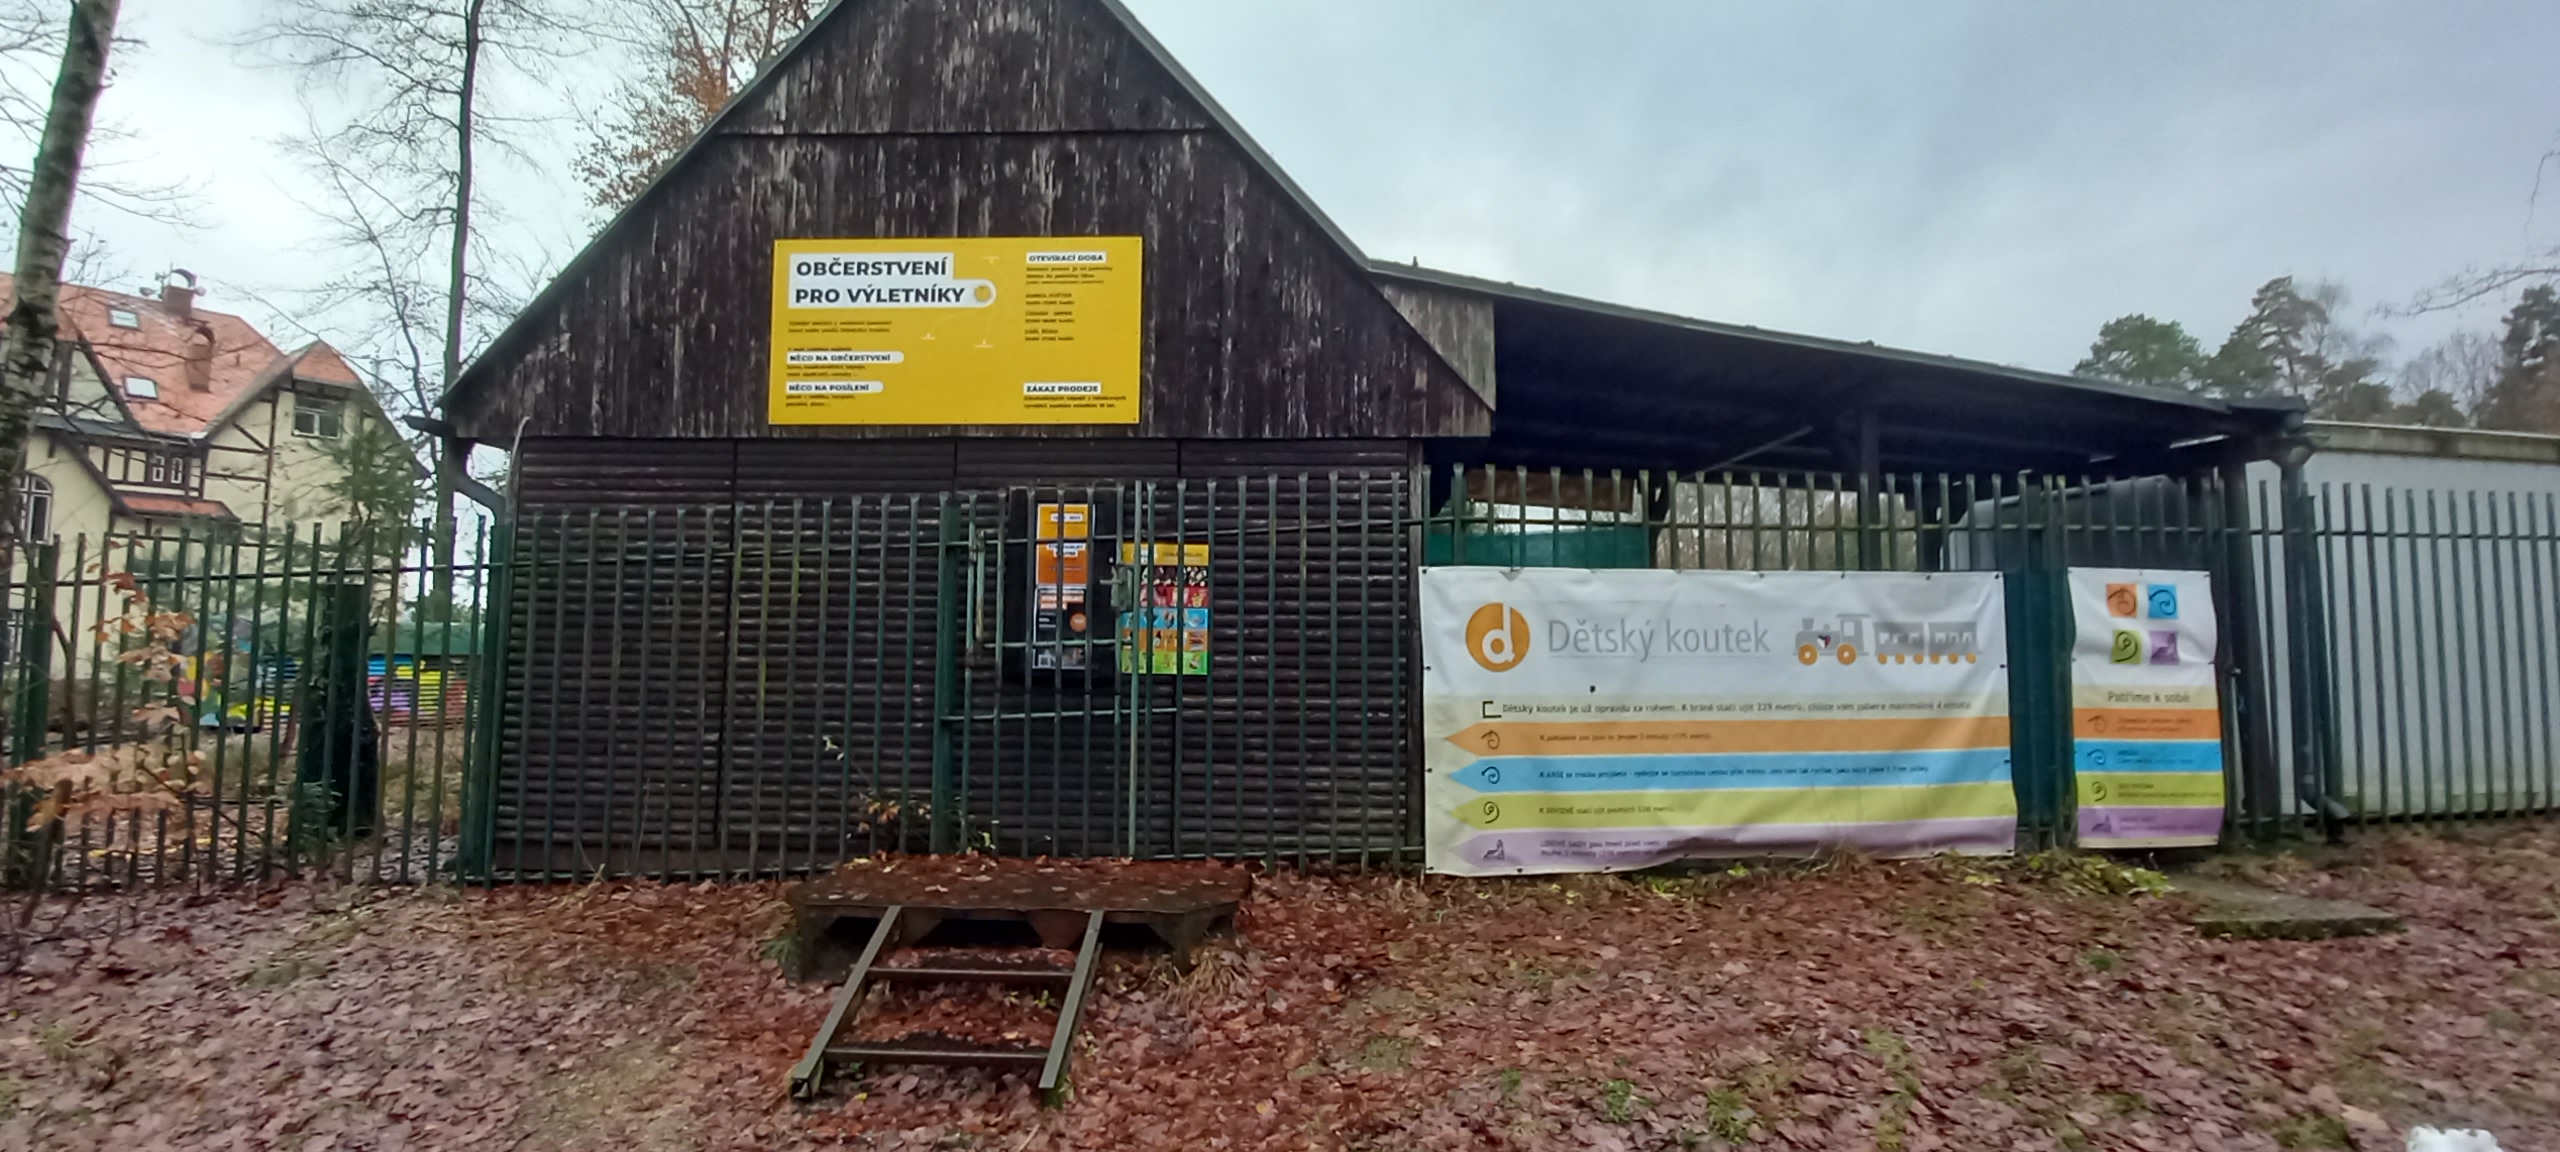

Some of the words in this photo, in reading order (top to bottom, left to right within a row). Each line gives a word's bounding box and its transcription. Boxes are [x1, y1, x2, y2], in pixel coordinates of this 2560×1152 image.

[796, 256, 948, 276] OBČERSTVENÍ
[795, 288, 840, 303] PRO
[847, 284, 965, 303] VÝLETNÍKY
[789, 353, 813, 361] NĚCO
[830, 353, 891, 361] OBČERSTVENÍ
[788, 383, 813, 391] NĚCO
[829, 383, 869, 391] POSÍLENÍ
[1026, 384, 1056, 392] ZÁKAZ
[1548, 618, 1655, 663] Dětský
[1666, 618, 1771, 654] koutek
[2108, 691, 2150, 702] Patříme
[2154, 691, 2161, 702] k
[2164, 691, 2190, 702] sobě
[1502, 704, 1533, 714] Dětský
[1536, 704, 1567, 713] koutek
[1569, 704, 1579, 714] je
[1581, 704, 1592, 713] už
[1595, 704, 1630, 714] opravdu
[1681, 703, 1688, 711] K
